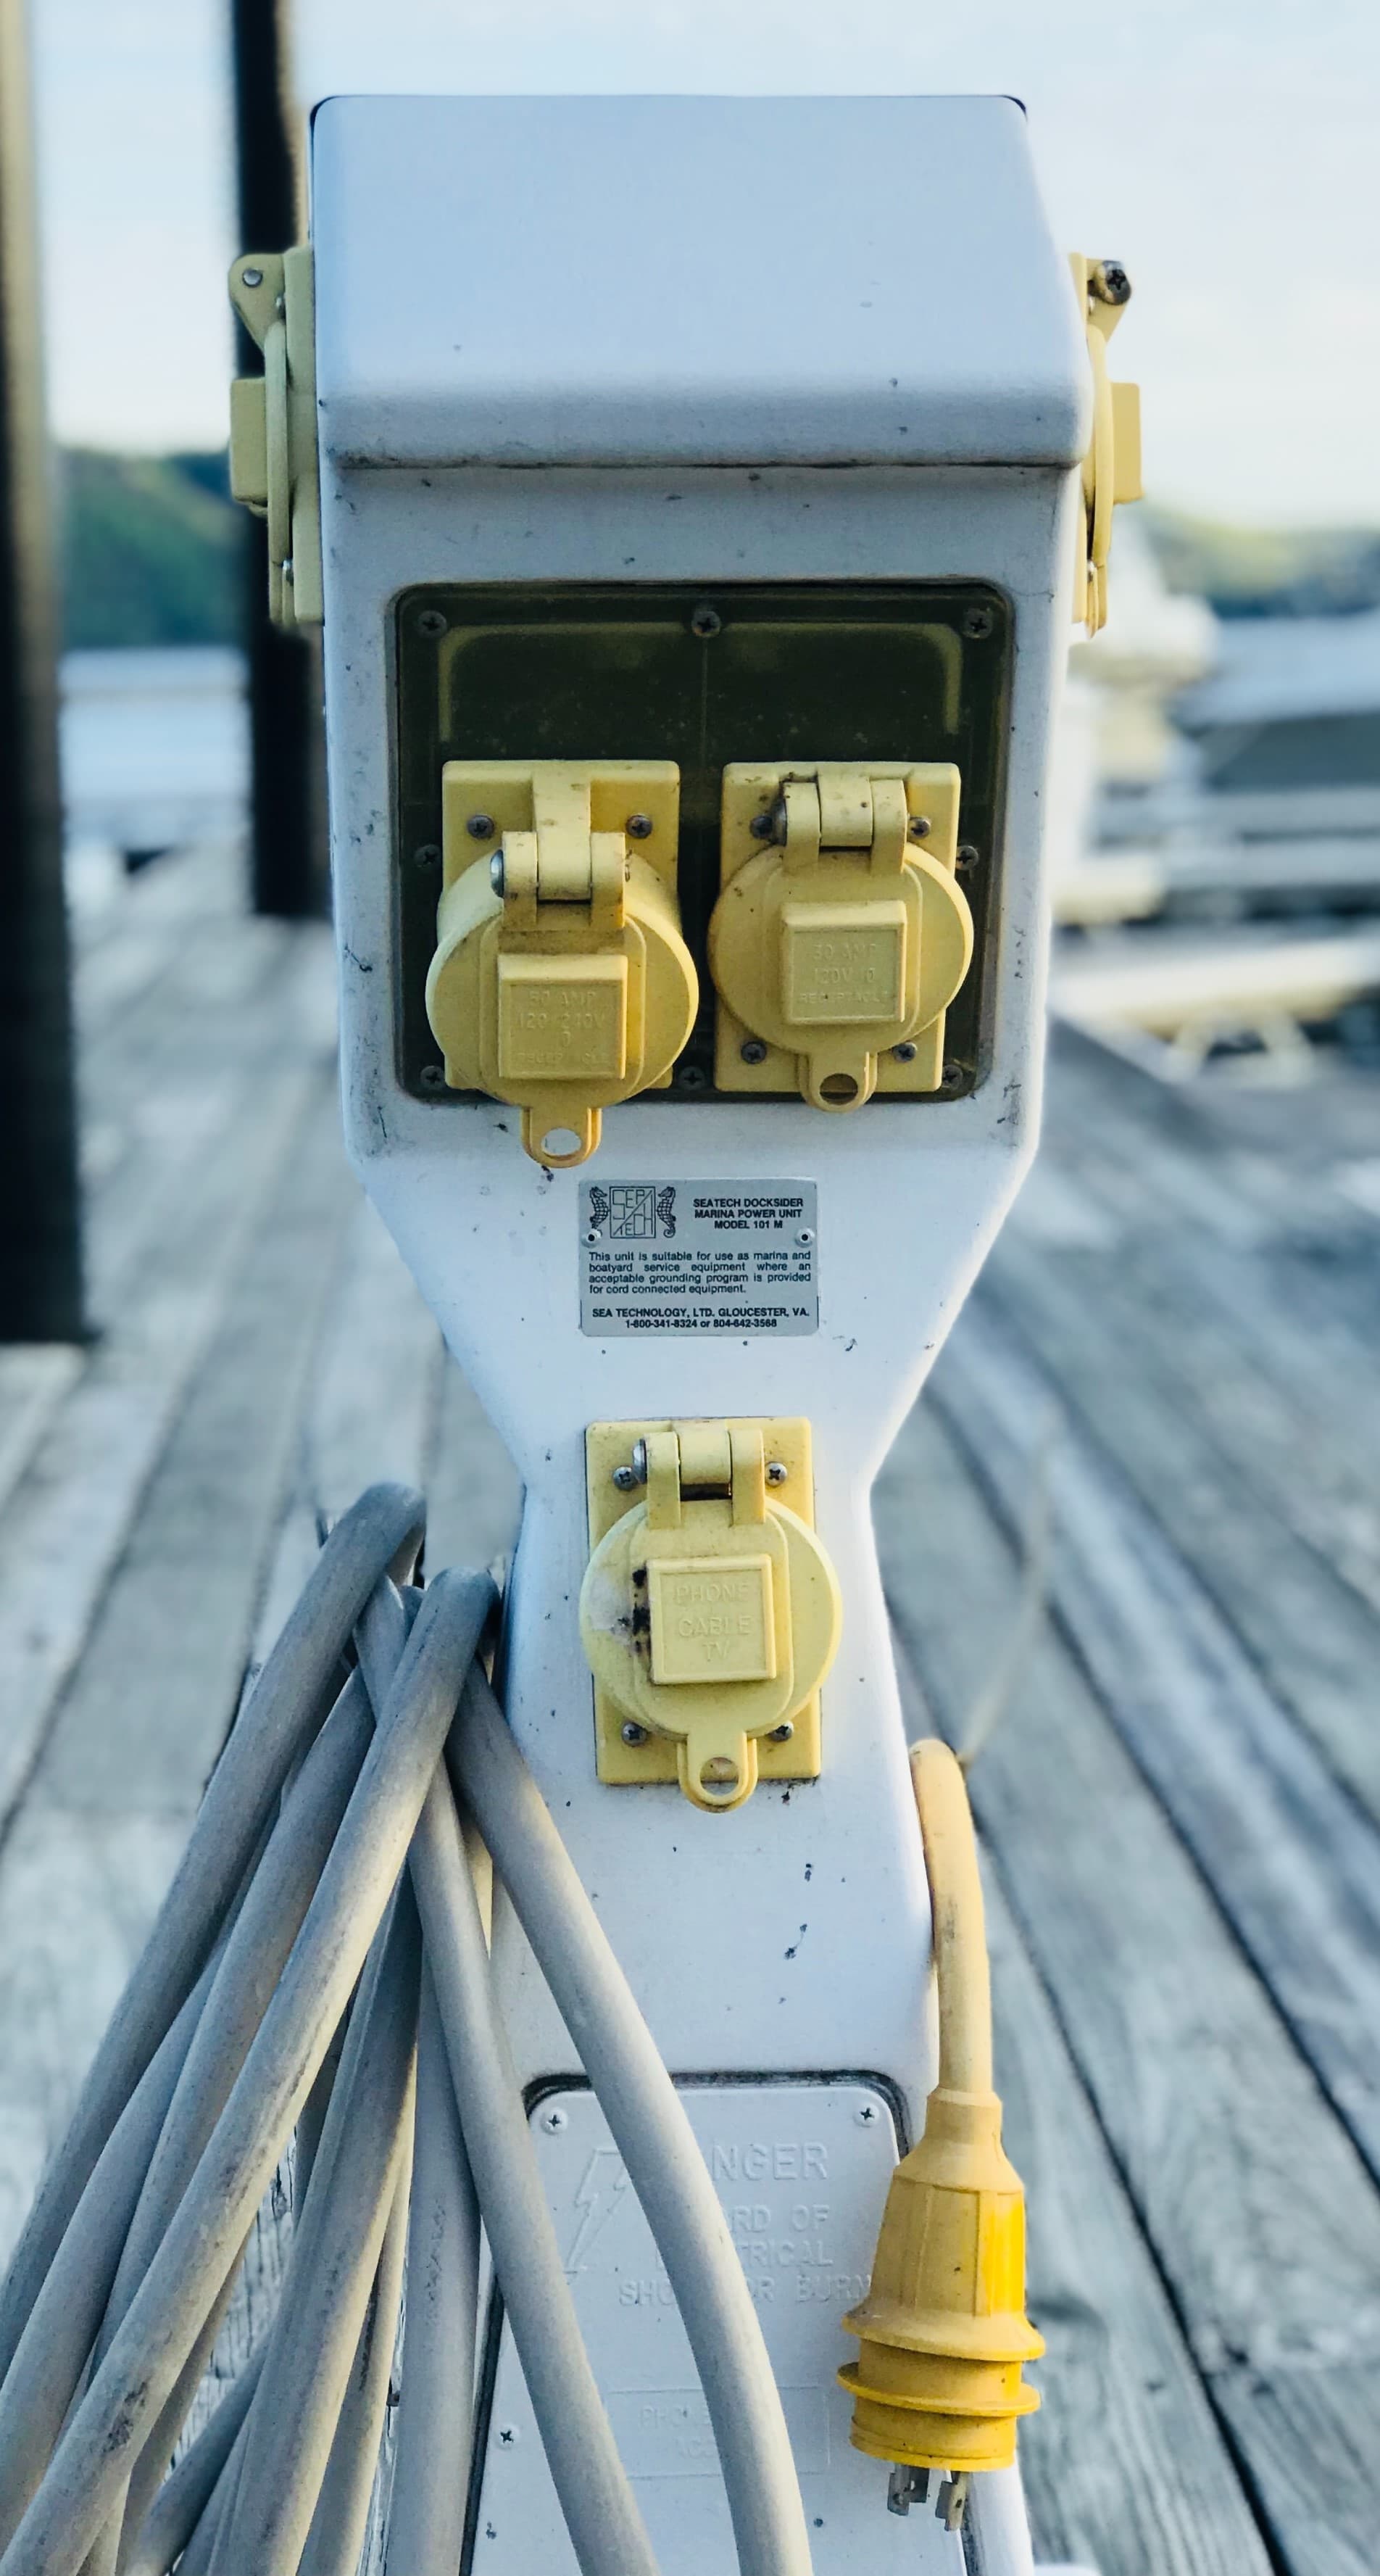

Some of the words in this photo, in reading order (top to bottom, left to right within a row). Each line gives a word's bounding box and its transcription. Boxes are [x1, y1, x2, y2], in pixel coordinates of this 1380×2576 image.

[693, 1198, 741, 1208] SEATECH
[744, 1198, 804, 1207] DOCKSIDER
[694, 1209, 735, 1218] MARINA
[738, 1209, 776, 1218] POWER
[778, 1209, 802, 1218] UNIT
[714, 1220, 750, 1229] MODEL
[753, 1220, 770, 1229] 101
[773, 1220, 783, 1229] M
[589, 1251, 610, 1261] This
[615, 1251, 634, 1261] unit
[639, 1252, 647, 1261] is
[652, 1251, 692, 1261] suitable
[697, 1251, 711, 1261] for
[753, 1251, 788, 1260] marina
[792, 1251, 811, 1260] and
[589, 1263, 633, 1274] boatyard
[644, 1263, 680, 1272] service
[691, 1262, 746, 1272] equipment
[757, 1262, 788, 1271] where
[589, 1274, 644, 1284] acceptable
[649, 1273, 701, 1284] grounding
[706, 1274, 749, 1283] program
[753, 1273, 762, 1282] is
[767, 1272, 811, 1283] provided
[589, 1285, 603, 1293] for
[606, 1285, 629, 1293] cord
[632, 1285, 686, 1293] connected
[689, 1284, 747, 1294] equipment.
[592, 1308, 612, 1317] SEA
[615, 1308, 690, 1318] TECHNOLOGY,
[693, 1308, 715, 1317] LTD.
[718, 1307, 789, 1317] GLOUCESTER,
[792, 1307, 810, 1317] VA.
[675, 1582, 749, 1605] PHONE
[678, 1615, 752, 1637] CABLE
[702, 1640, 731, 1662] TV
[711, 2141, 828, 2181] NGER
[792, 2204, 830, 2233] OF
